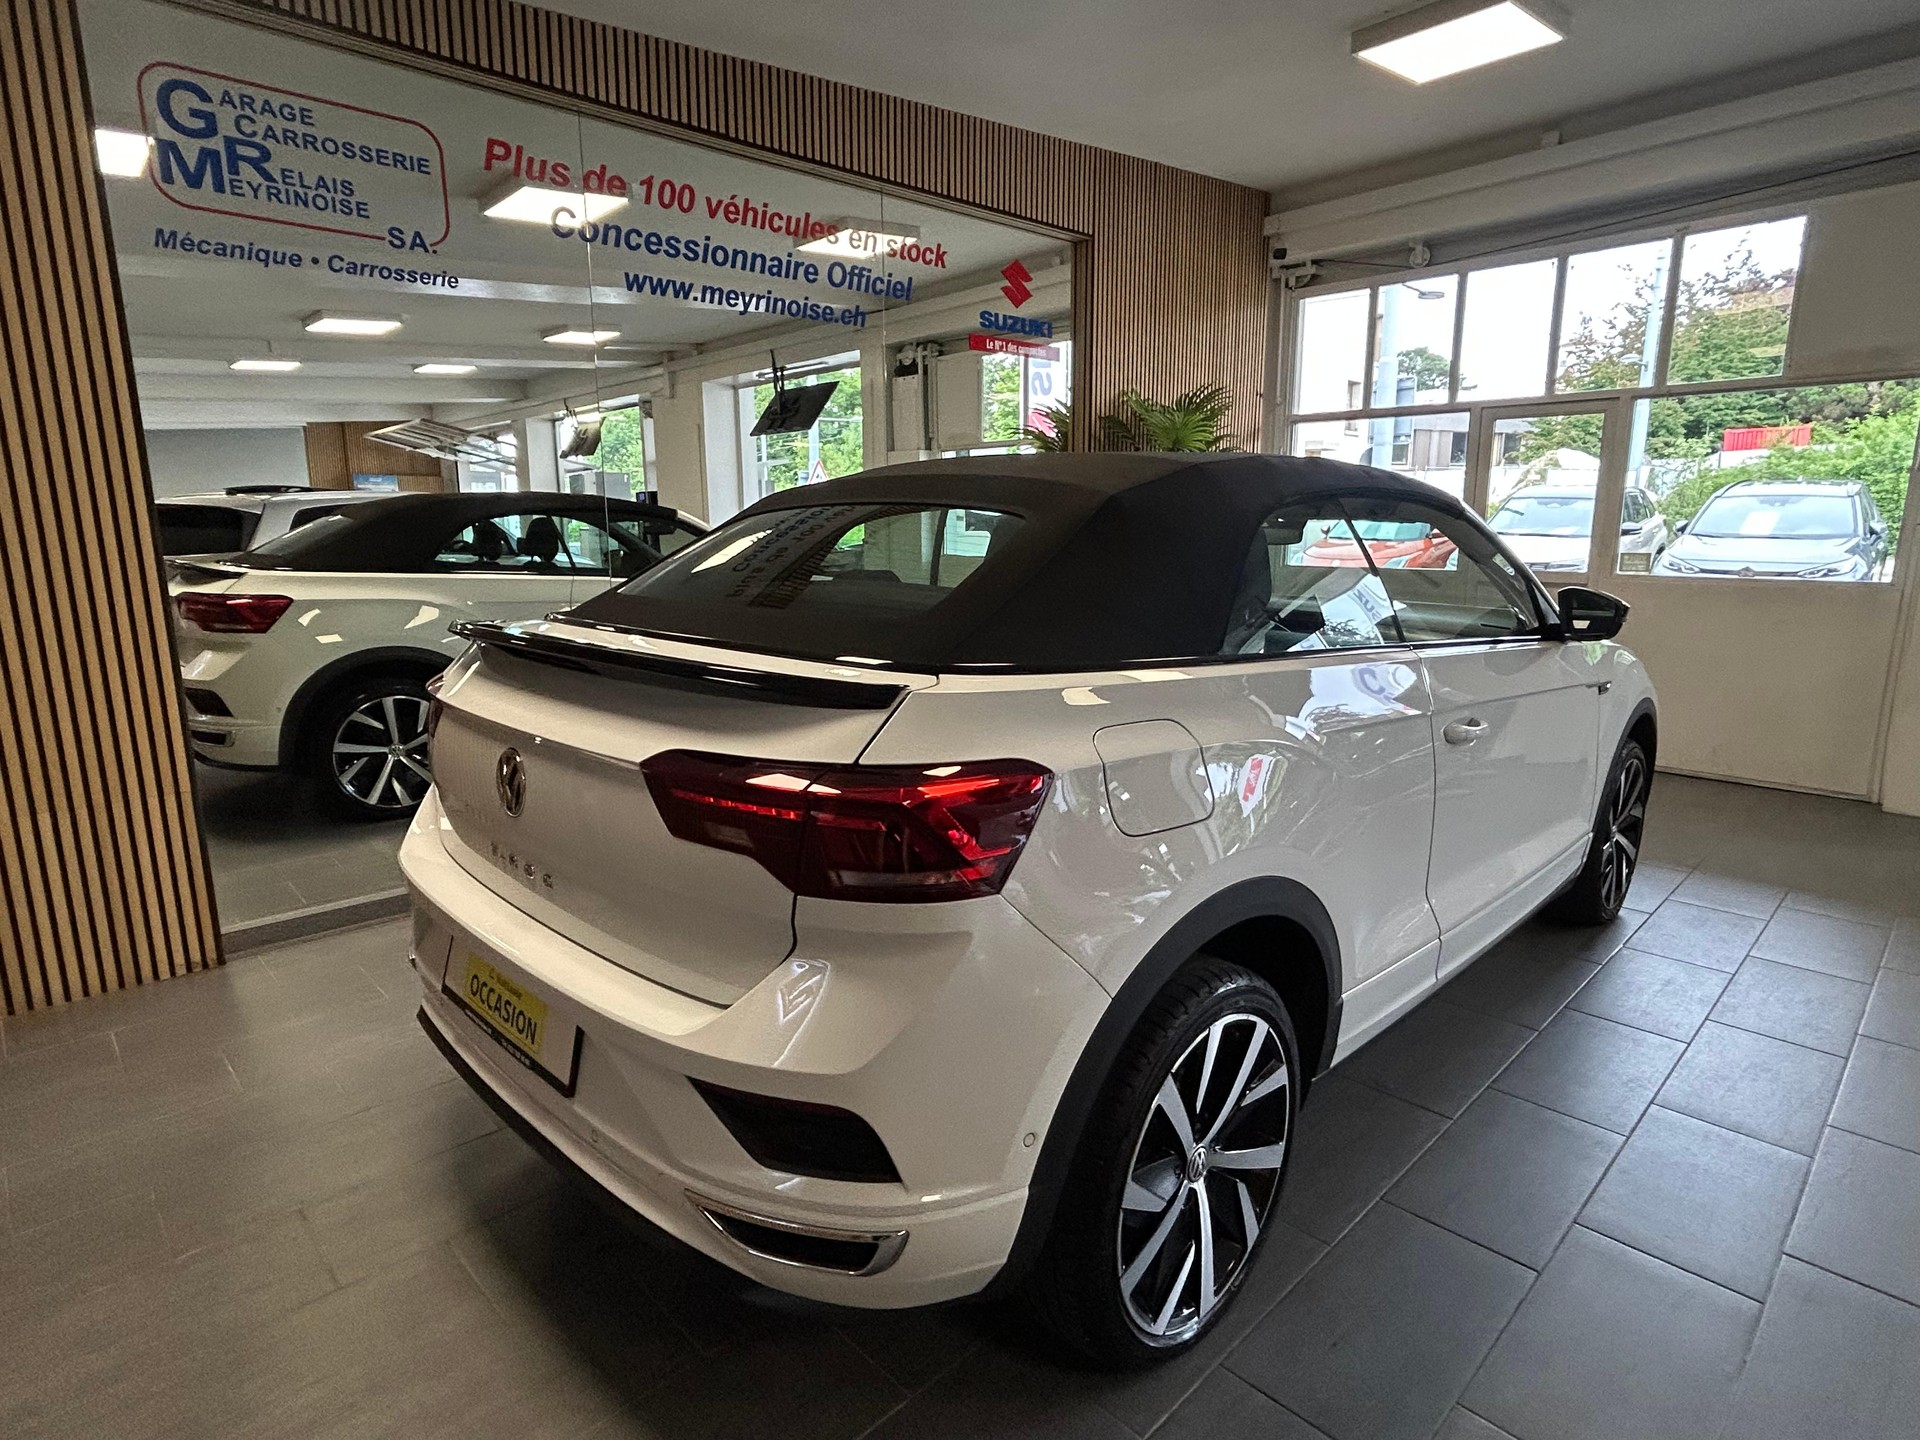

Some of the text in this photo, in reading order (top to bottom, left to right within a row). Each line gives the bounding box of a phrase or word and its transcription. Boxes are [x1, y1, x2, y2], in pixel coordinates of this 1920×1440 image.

[156, 78, 316, 139] GARAGE
[234, 114, 431, 175] CARROSSERIE
[483, 137, 947, 269] Plus de 100 véhicules en stock
[154, 227, 459, 289] Mécanique Carrosserie
[550, 206, 913, 301] Concessionnaire Officiel
[624, 271, 867, 328] www.meyrinoise.ch
[979, 310, 1053, 338] SUZUKI
[986, 339, 994, 350] Le
[1007, 341, 1018, 353] des
[469, 973, 538, 1045] OCCASION
